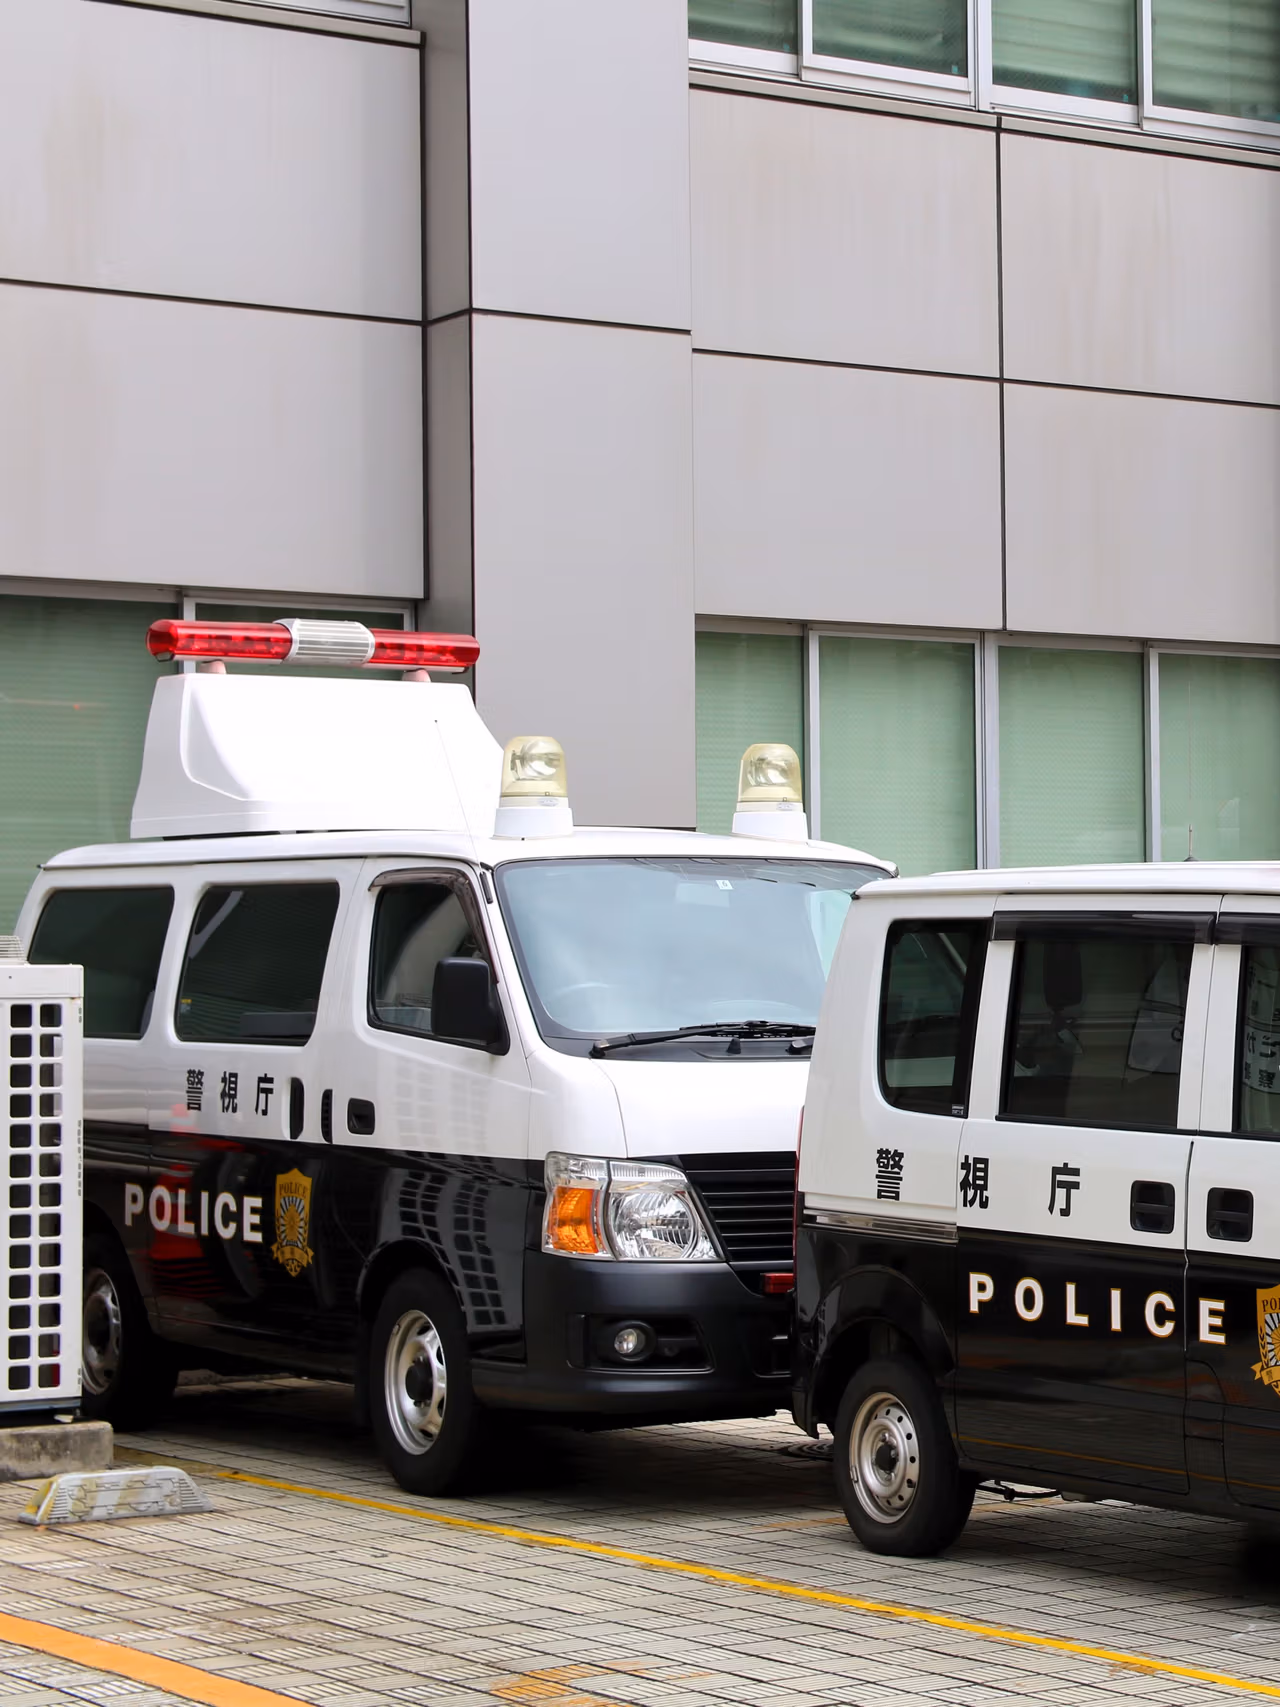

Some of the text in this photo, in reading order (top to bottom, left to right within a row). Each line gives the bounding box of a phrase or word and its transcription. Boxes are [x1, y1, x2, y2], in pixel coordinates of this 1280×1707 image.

[186, 1068, 274, 1116] 警視庁
[124, 1182, 264, 1243] POLICE
[279, 1182, 308, 1199] POLICE
[876, 1148, 1081, 1217] 警視庁
[968, 1271, 1227, 1345] POLICE
